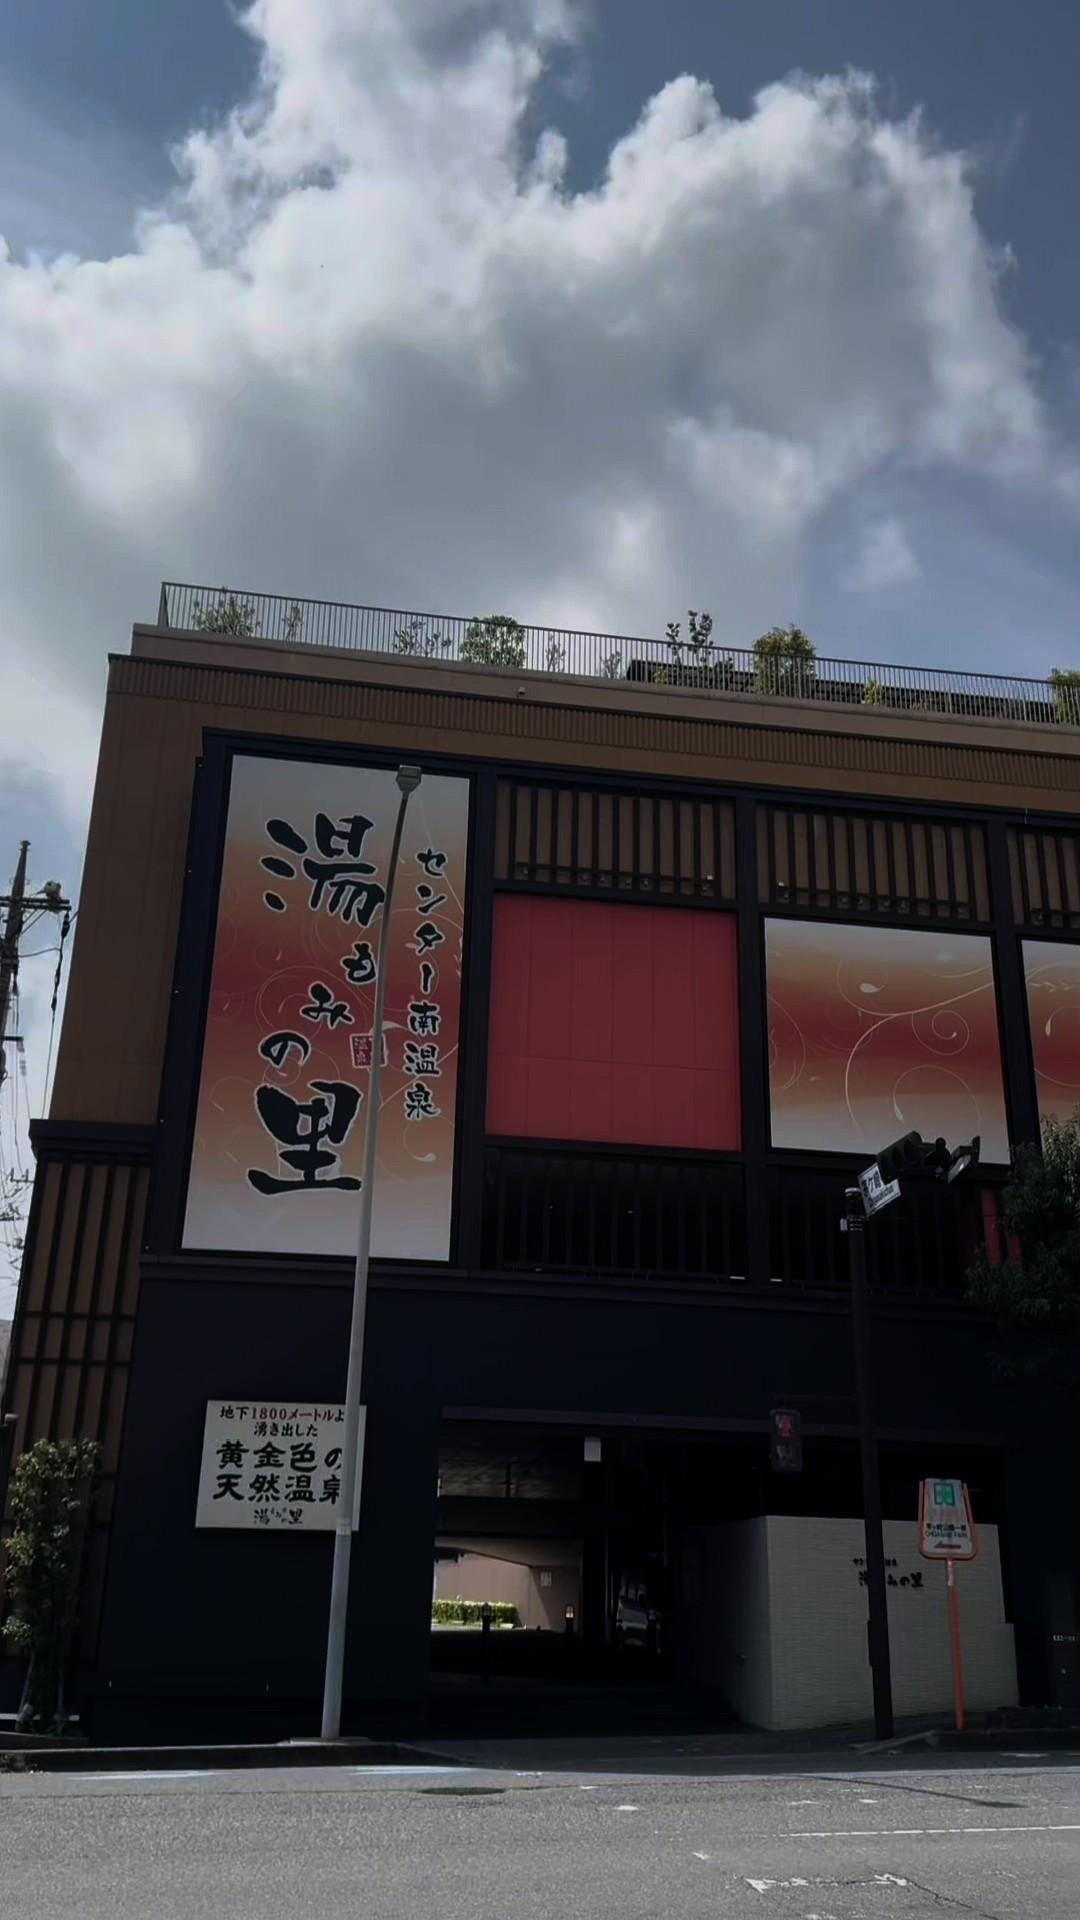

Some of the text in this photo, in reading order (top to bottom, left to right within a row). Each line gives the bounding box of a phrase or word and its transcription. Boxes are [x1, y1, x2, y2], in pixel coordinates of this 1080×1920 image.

[401, 847, 446, 1121] センター南温泉
[248, 813, 386, 1195] 湯もみの里
[220, 1405, 345, 1422] 地下1800メートルよ
[253, 1422, 318, 1437] 湧き出した
[216, 1439, 342, 1472] 黄金色の
